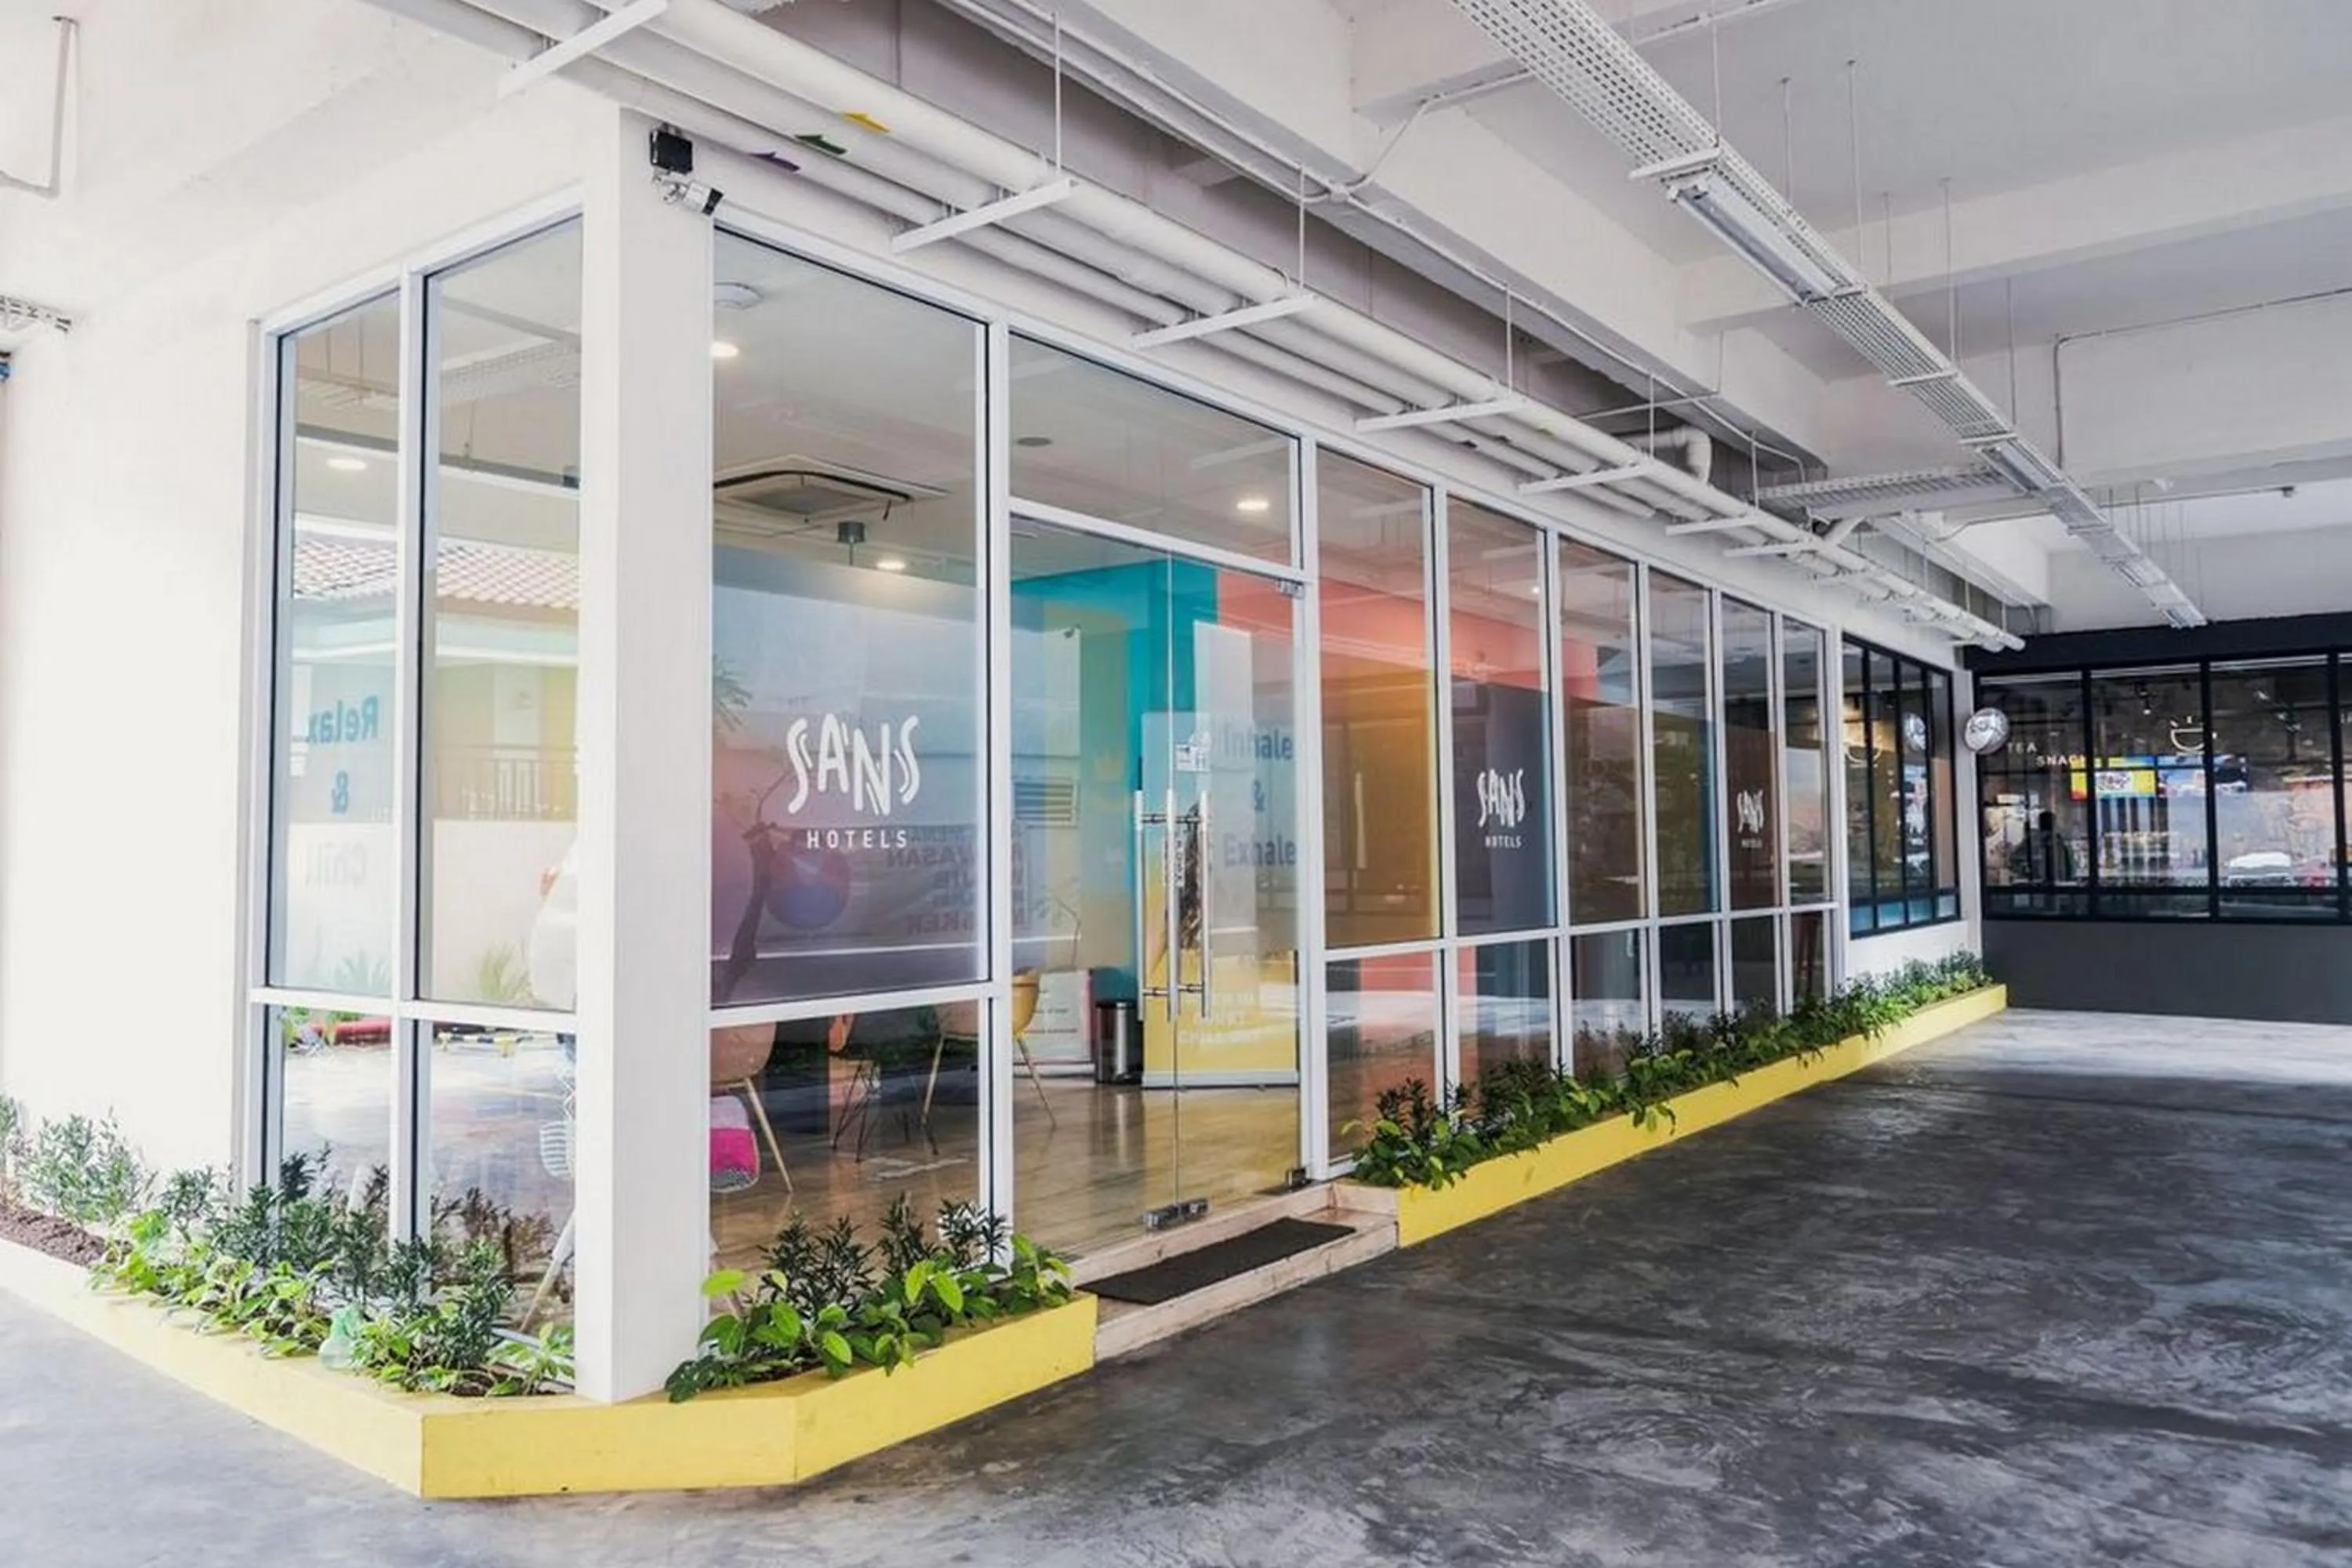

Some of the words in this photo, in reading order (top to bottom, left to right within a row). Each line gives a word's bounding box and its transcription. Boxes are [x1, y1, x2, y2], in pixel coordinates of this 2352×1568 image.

[1224, 724, 1294, 760] Inhale
[787, 713, 920, 815] SANS
[1477, 768, 1525, 828] SANS
[807, 829, 907, 849] HOTELS
[1224, 833, 1297, 868] Exhale
